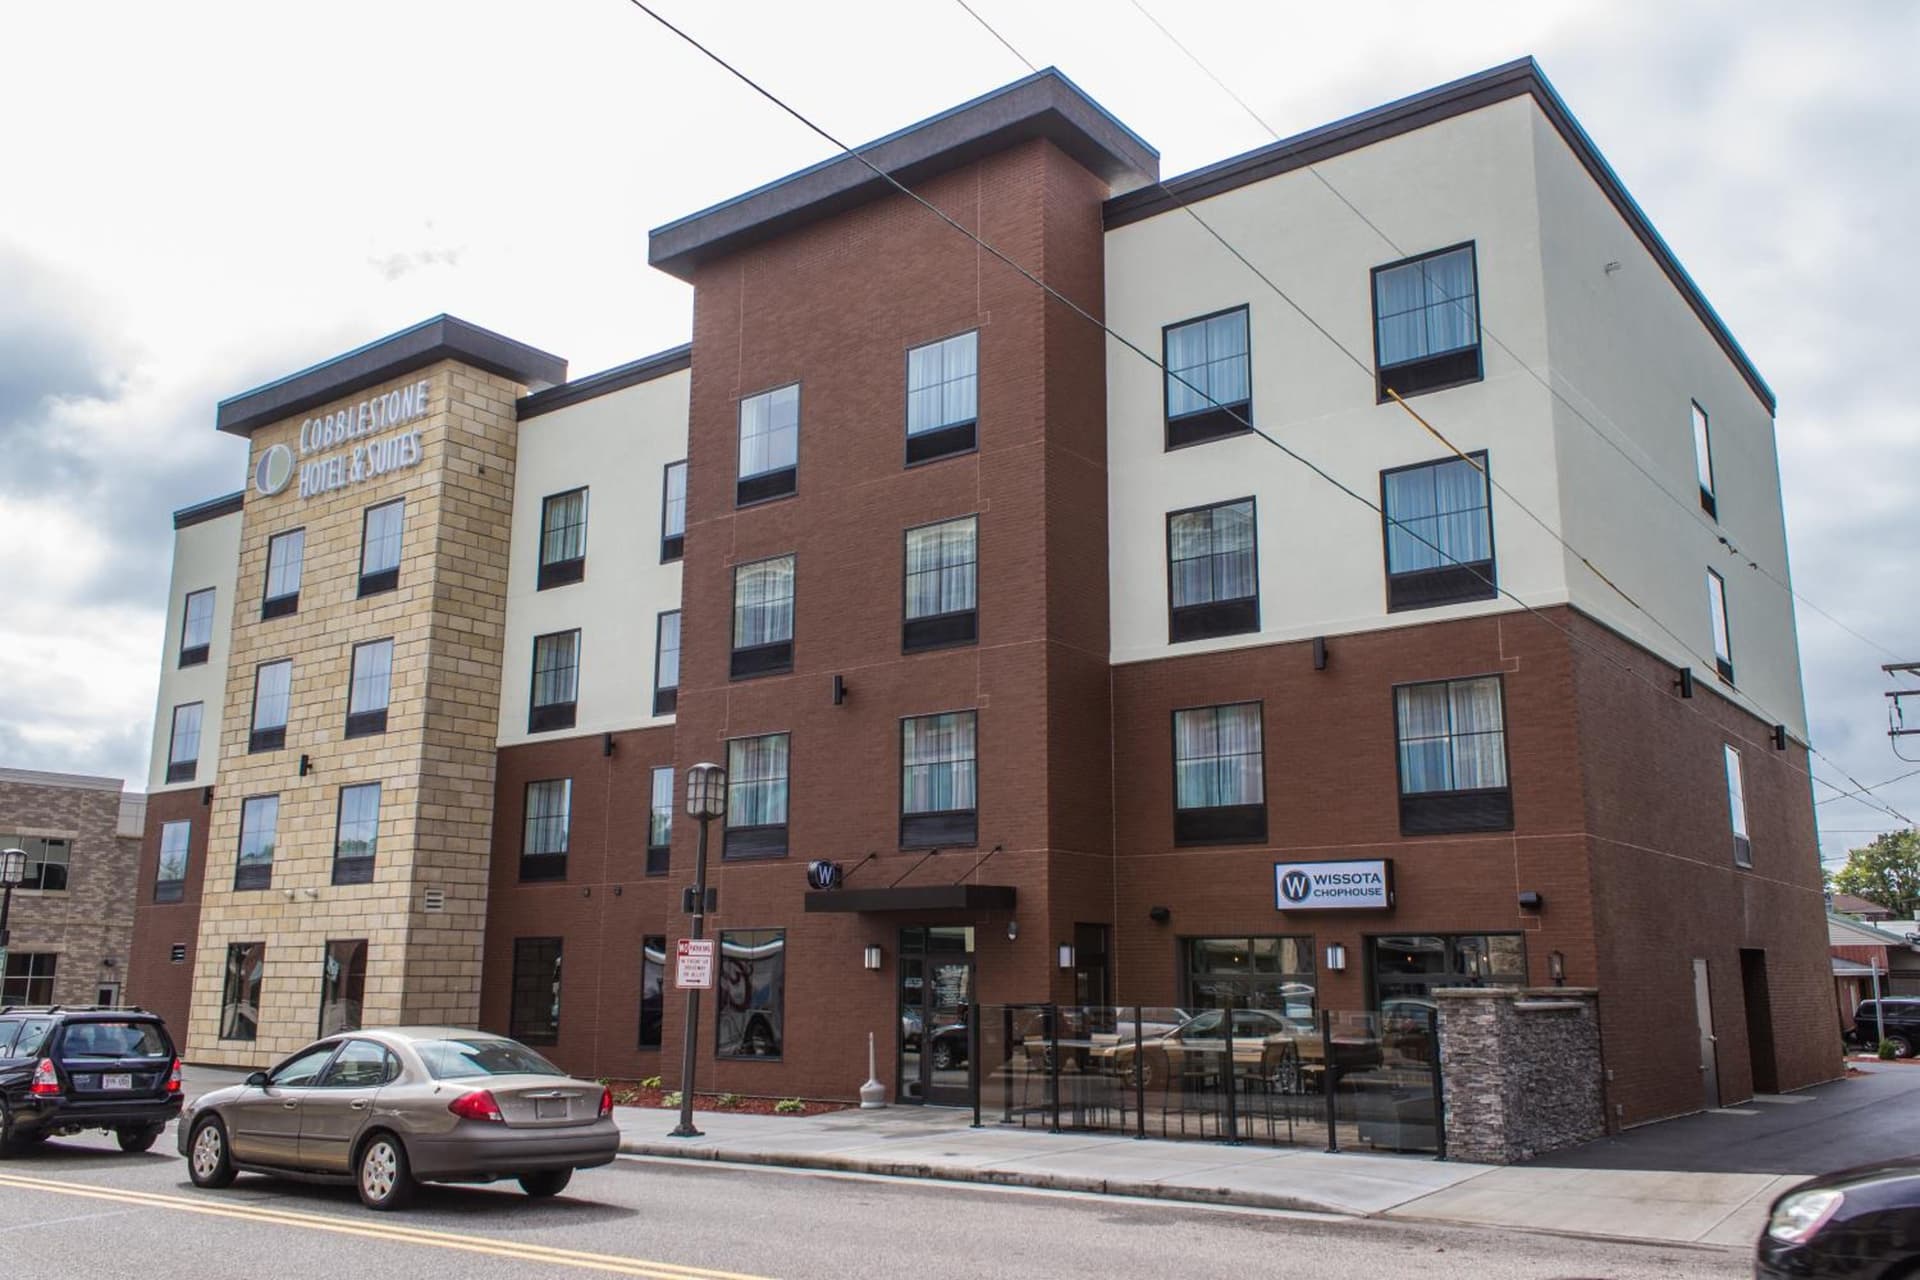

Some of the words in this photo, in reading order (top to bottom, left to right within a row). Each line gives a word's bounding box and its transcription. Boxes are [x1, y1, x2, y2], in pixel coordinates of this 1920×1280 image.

[301, 380, 430, 455] COBBLESTONE
[299, 455, 348, 498] HOTEL
[350, 446, 367, 483] &
[367, 429, 423, 478] SUITES
[819, 865, 833, 884] W
[1313, 872, 1382, 885] WISSOTA
[1286, 876, 1306, 898] W
[1313, 887, 1382, 897] CHOPHOUSE
